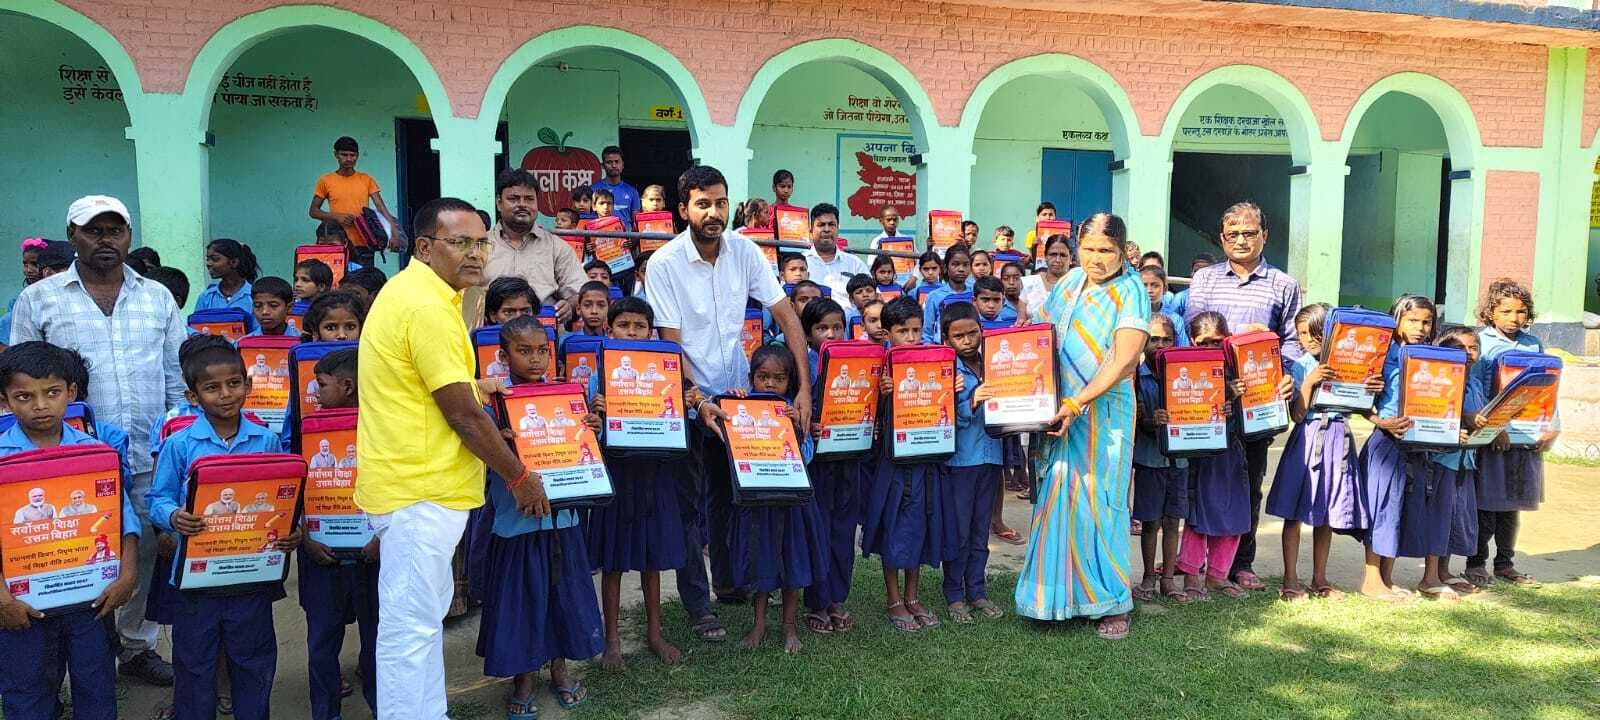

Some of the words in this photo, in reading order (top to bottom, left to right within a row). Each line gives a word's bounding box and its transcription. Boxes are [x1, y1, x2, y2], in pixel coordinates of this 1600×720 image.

[58, 64, 93, 83] शिक्षा
[96, 65, 111, 83] से
[221, 93, 249, 105] पाया
[249, 94, 266, 107] जा
[267, 95, 302, 108] सकता
[847, 94, 869, 109] शिक्षा
[872, 96, 881, 108] वो
[837, 108, 864, 121] जितना
[1062, 130, 1092, 140] एकलव्य
[864, 142, 897, 153] अपना
[562, 169, 595, 192] कक्ष
[10, 521, 50, 536] सर्वोत्तम
[53, 517, 80, 529] शिक्षा
[23, 533, 49, 545] उत्तम
[50, 528, 78, 541] बिहार
[32, 561, 48, 569] शिक्षा
